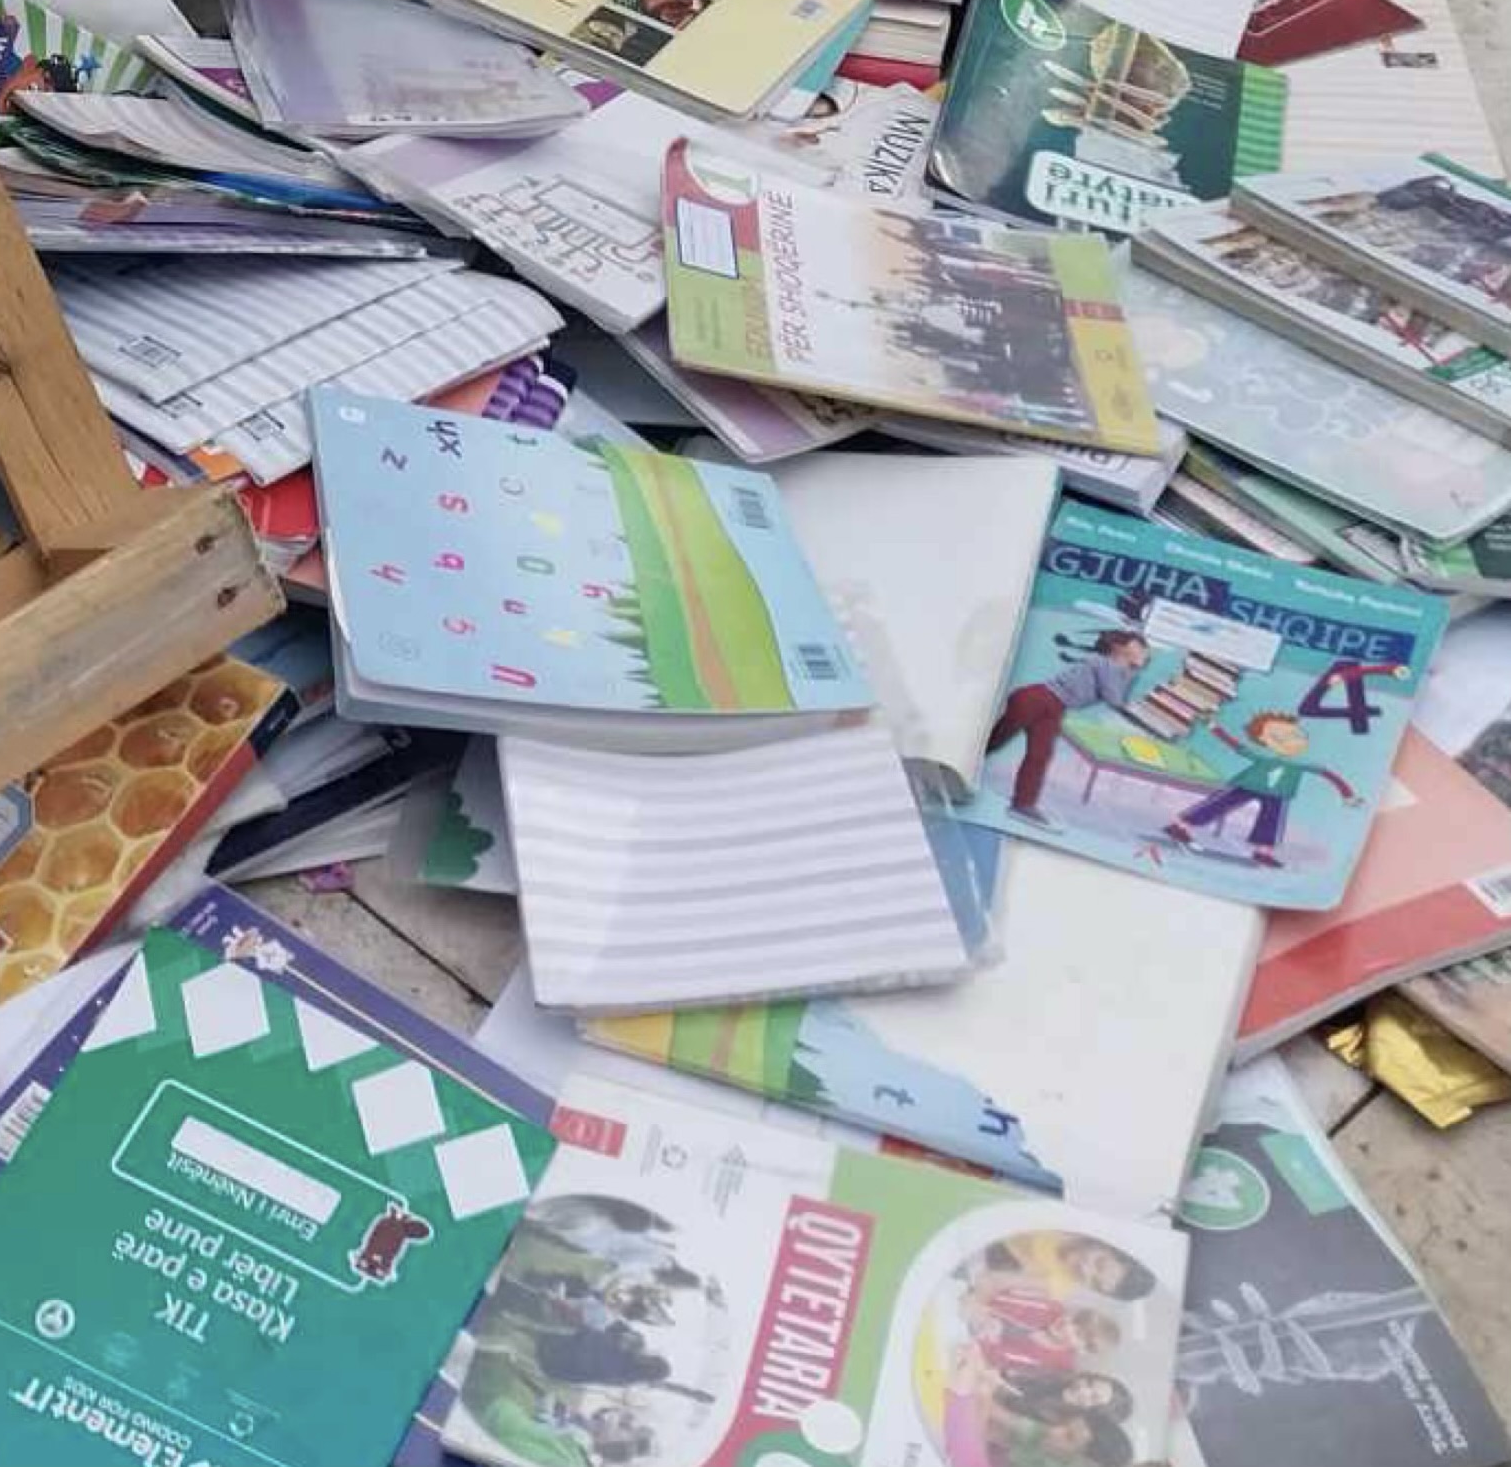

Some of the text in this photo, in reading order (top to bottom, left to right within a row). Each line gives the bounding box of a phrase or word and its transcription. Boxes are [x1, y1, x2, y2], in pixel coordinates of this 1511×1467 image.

[1047, 545, 1393, 659] GJUHA SHQIPE
[1297, 660, 1383, 736] 4
[111, 1230, 296, 1344] Klasa e parë
[144, 1207, 300, 1306] Libër pune
[153, 1291, 210, 1344] TIK
[753, 1209, 863, 1421] QYTETARIA
